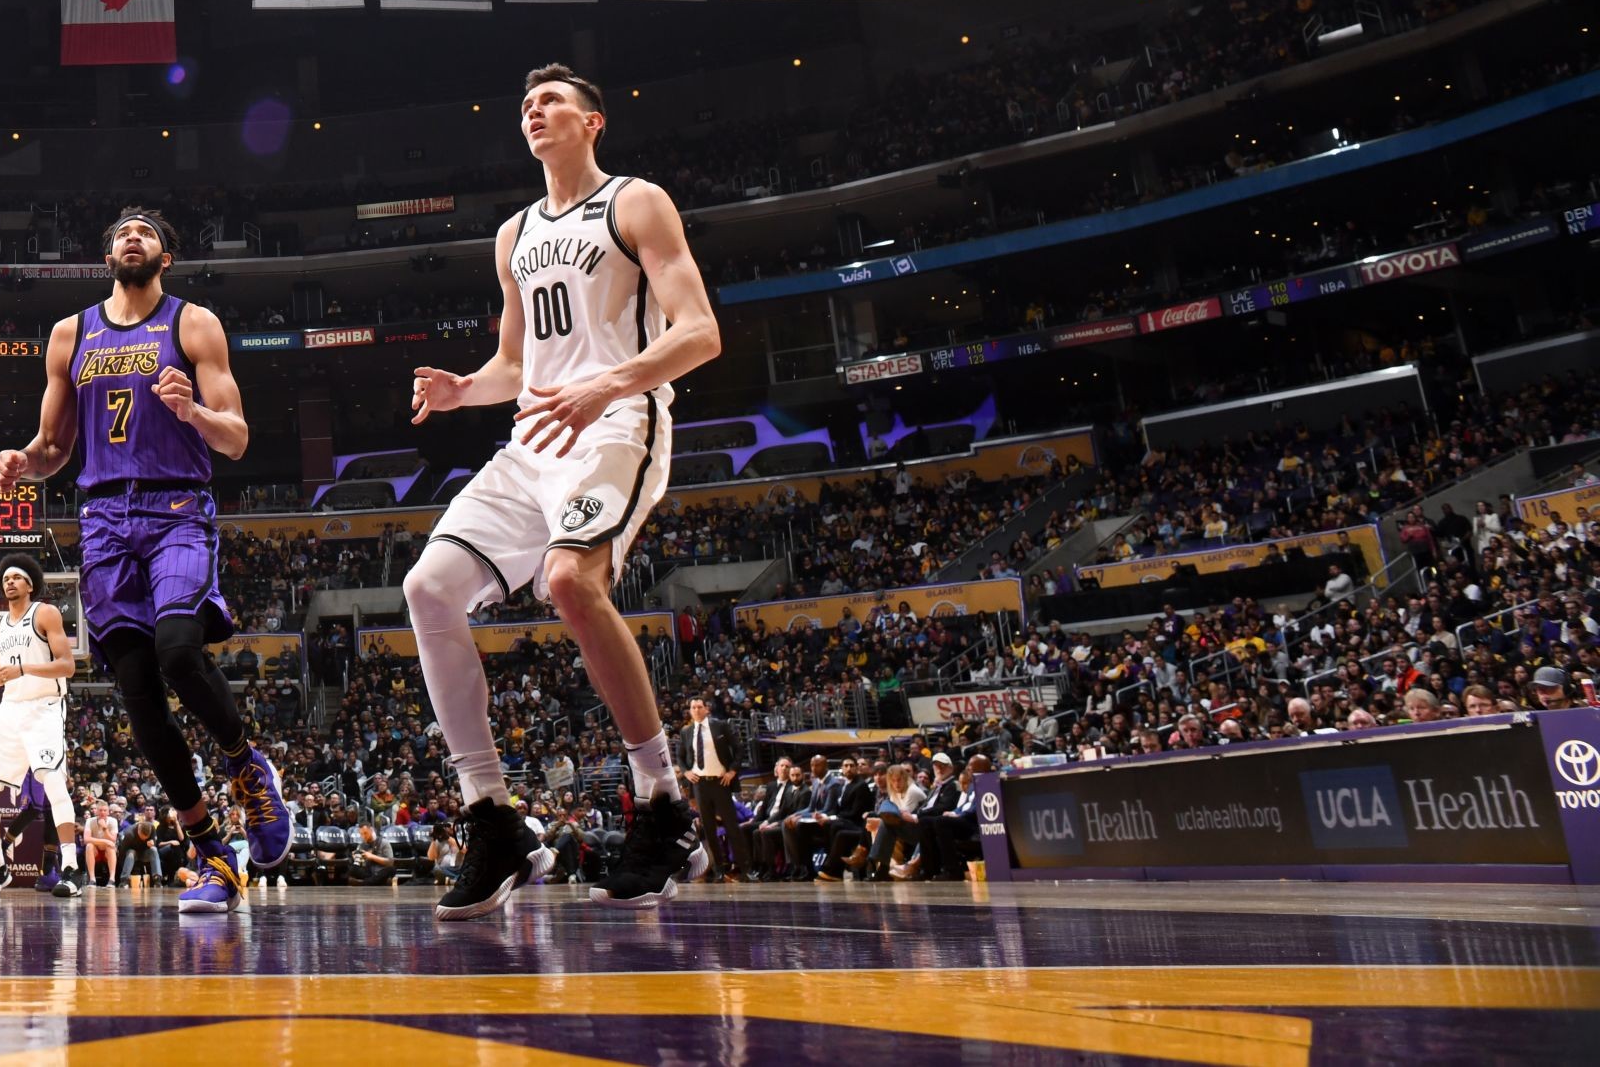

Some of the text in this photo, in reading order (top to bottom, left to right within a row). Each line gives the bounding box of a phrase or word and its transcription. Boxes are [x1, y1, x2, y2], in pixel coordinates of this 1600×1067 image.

[584, 205, 605, 215] infor
[1564, 205, 1594, 222] DEN
[1567, 220, 1586, 235] NY
[513, 237, 606, 292] BROOKLYN
[1361, 247, 1457, 282] TOYOTA
[52, 269, 82, 279] LOCATION
[838, 269, 872, 284] wish
[1319, 279, 1346, 295] NBA
[1230, 290, 1252, 303] LAC
[532, 281, 573, 341] 00
[1232, 301, 1255, 315] CLE
[145, 324, 169, 332] wish
[437, 321, 454, 331] LAL
[456, 320, 478, 329] BKN
[241, 337, 290, 347] BUD LIGHT
[305, 330, 373, 346] TOSHIBA
[33, 346, 40, 355] 3
[99, 342, 160, 355] LOS ANGELES
[1018, 344, 1040, 356] NBA
[76, 349, 160, 388] LAKERS
[848, 358, 920, 382] STAPLES
[107, 388, 134, 444] 7
[562, 496, 600, 516] NETS
[1521, 500, 1550, 519] 118
[3, 535, 42, 543] TISSOT
[1201, 550, 1255, 563] LAKERS.COM
[925, 587, 963, 598] @LAKERS
[362, 634, 385, 646] 116
[1029, 775, 1540, 842] UCLA Health uclahealth.org UCLA Health
[980, 822, 1006, 836] TOYOTA
